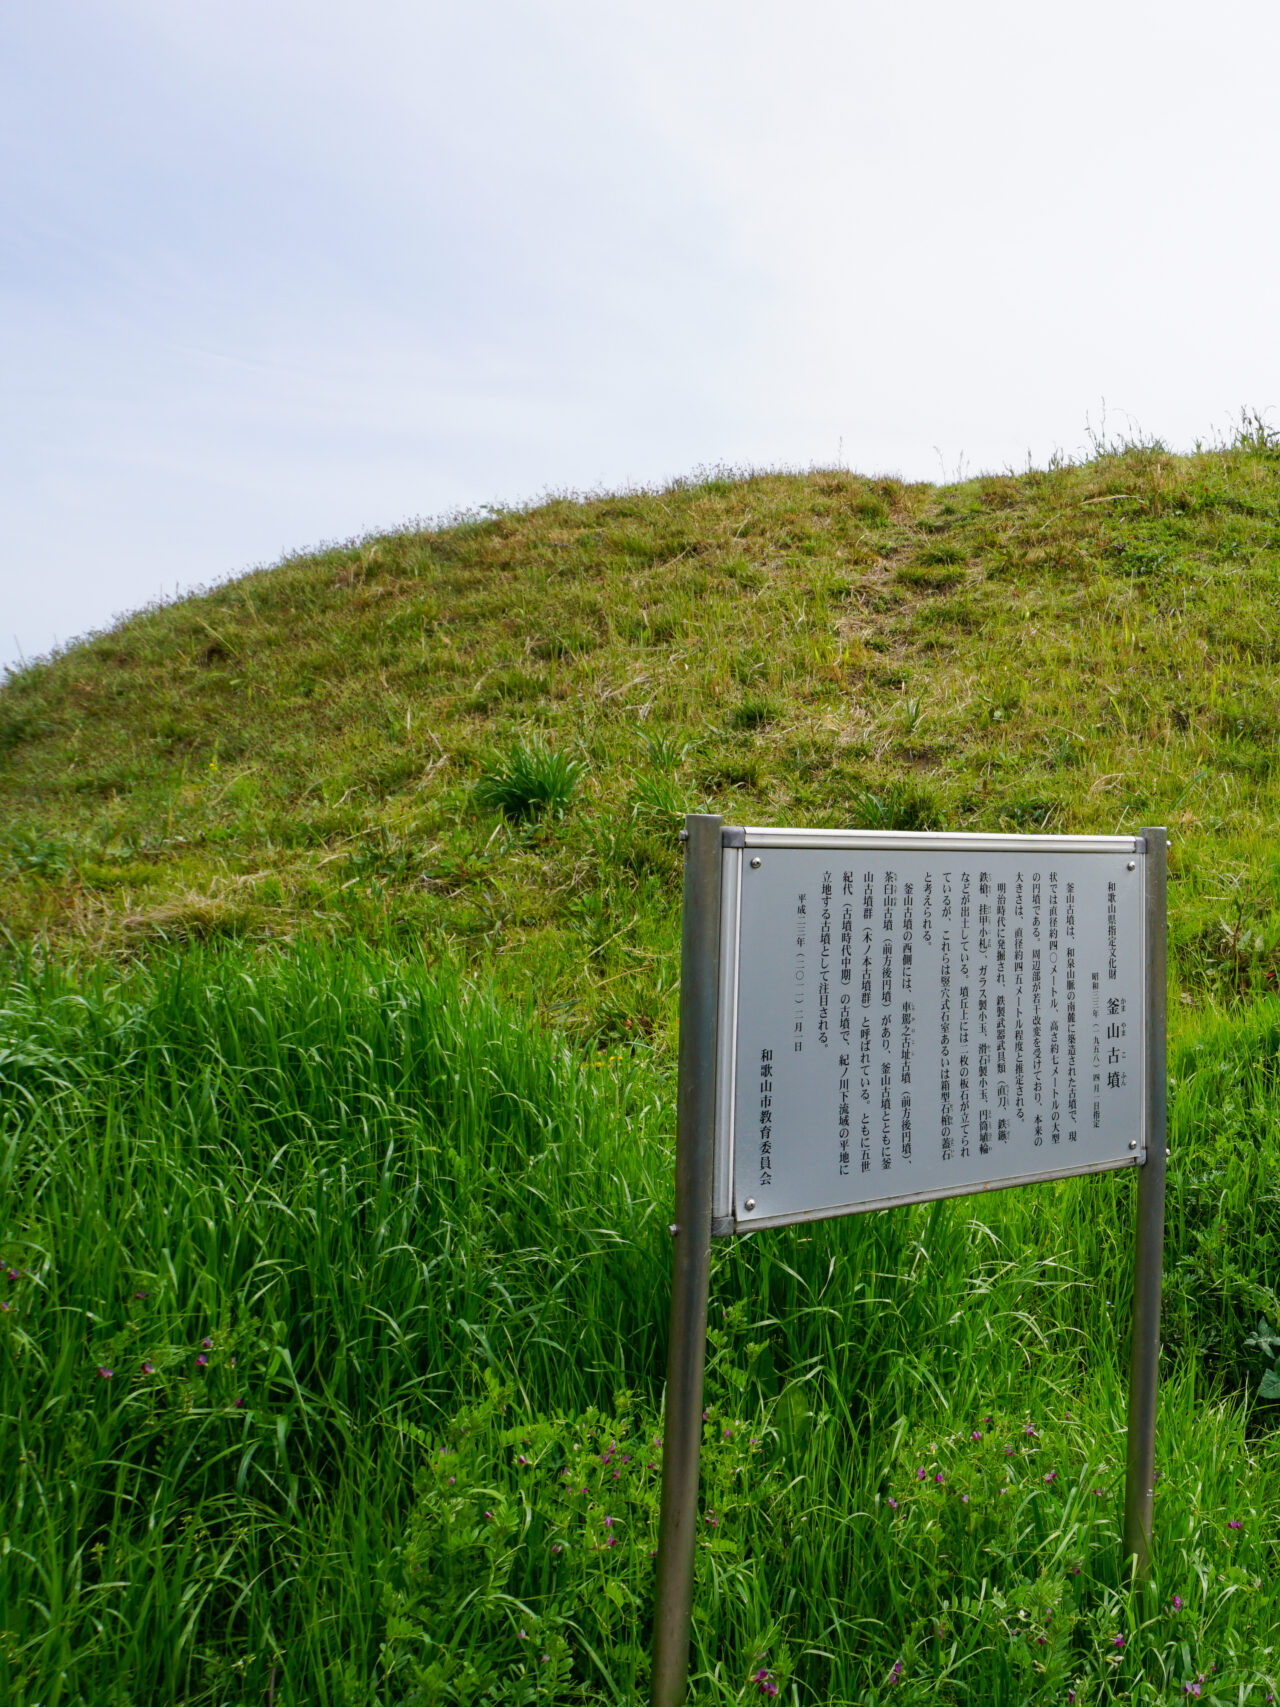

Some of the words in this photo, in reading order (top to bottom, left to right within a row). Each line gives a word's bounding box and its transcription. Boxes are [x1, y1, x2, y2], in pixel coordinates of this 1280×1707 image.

[818, 871, 832, 1048] 立地する古墳として注目される。
[923, 872, 932, 945] と考えられる。
[1107, 881, 1117, 980] 和歌山県指定文化財
[1014, 872, 1024, 1122] 大きさは、直径約四五メートル程度と推定される。
[1107, 998, 1120, 1089] 釜山古墳
[759, 1049, 773, 1186] 和歌山市教育委員会
